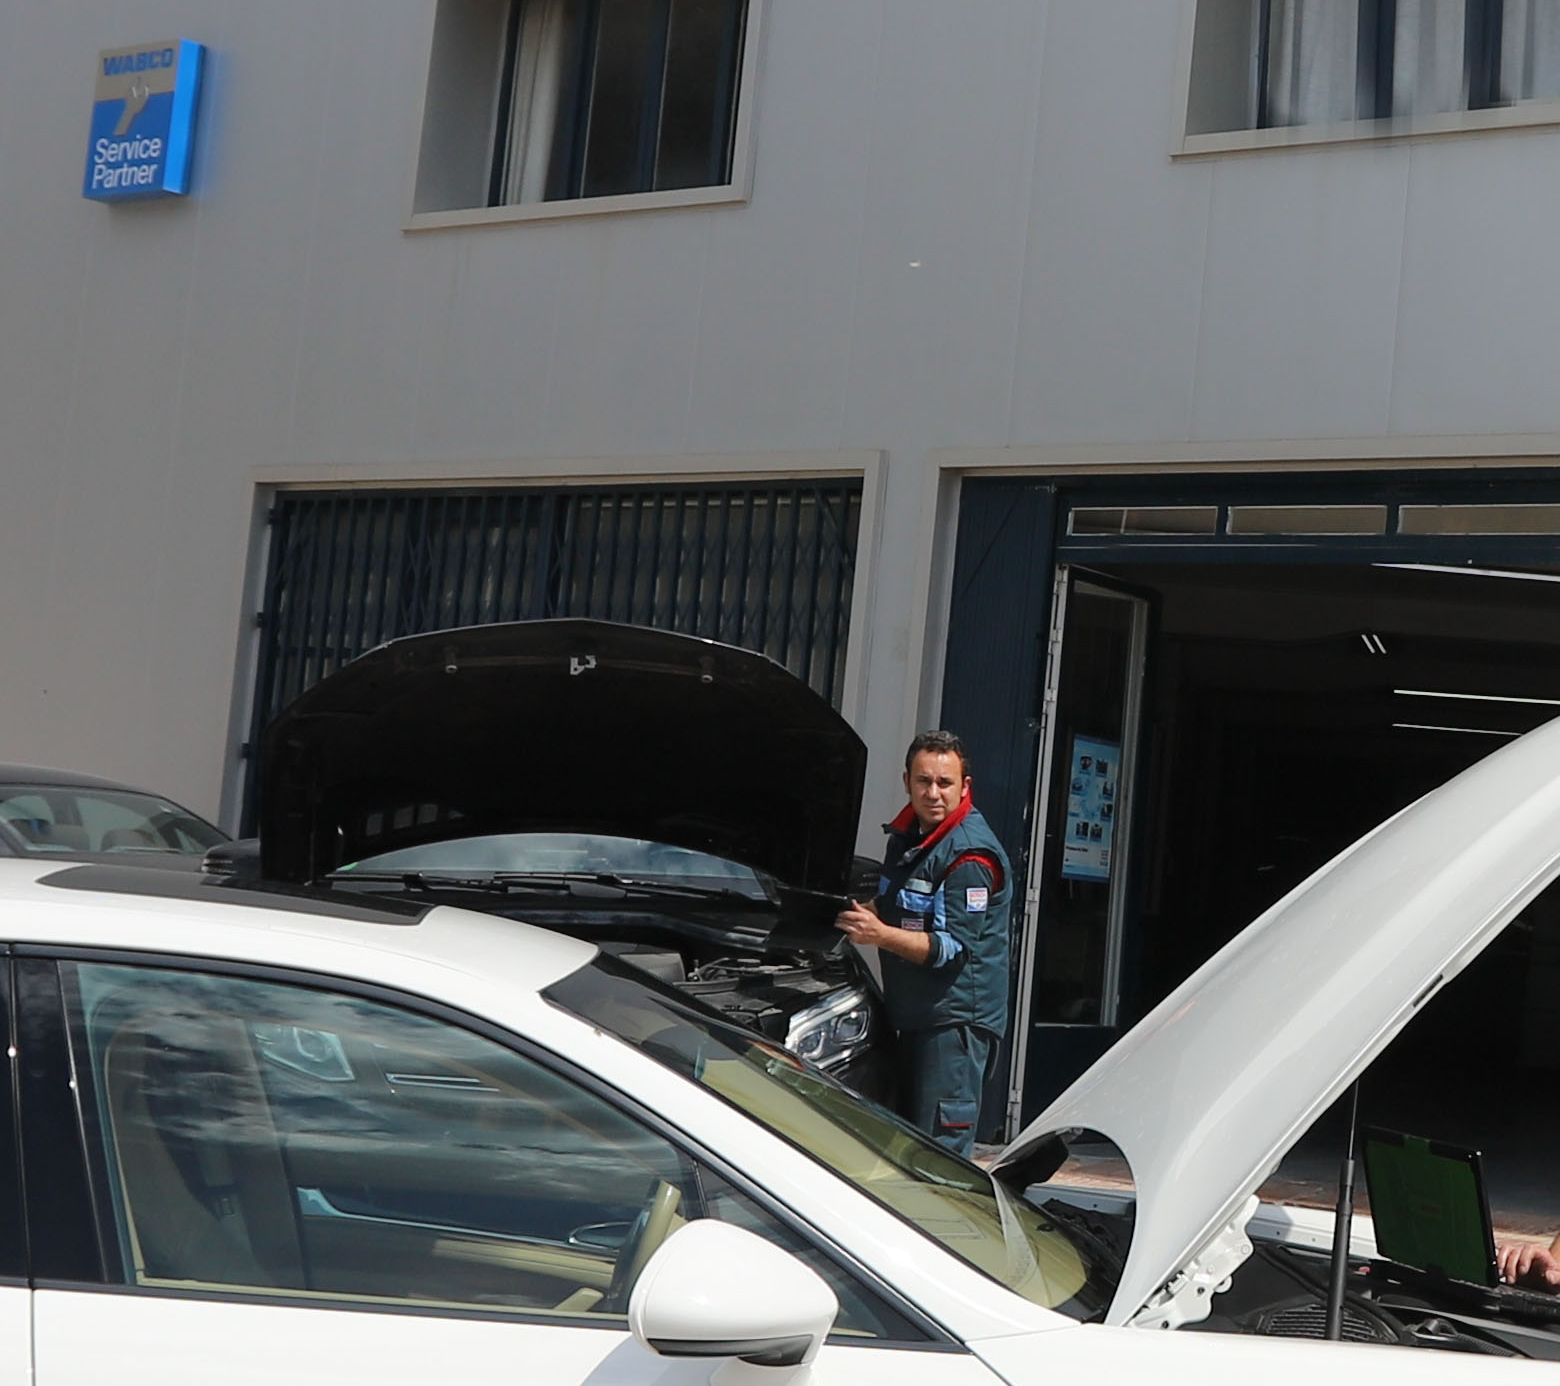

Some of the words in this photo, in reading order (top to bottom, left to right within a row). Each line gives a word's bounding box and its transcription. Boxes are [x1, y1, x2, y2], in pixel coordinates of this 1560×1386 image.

[103, 48, 174, 76] WABCO
[94, 134, 161, 163] Service
[92, 163, 158, 189] Partner
